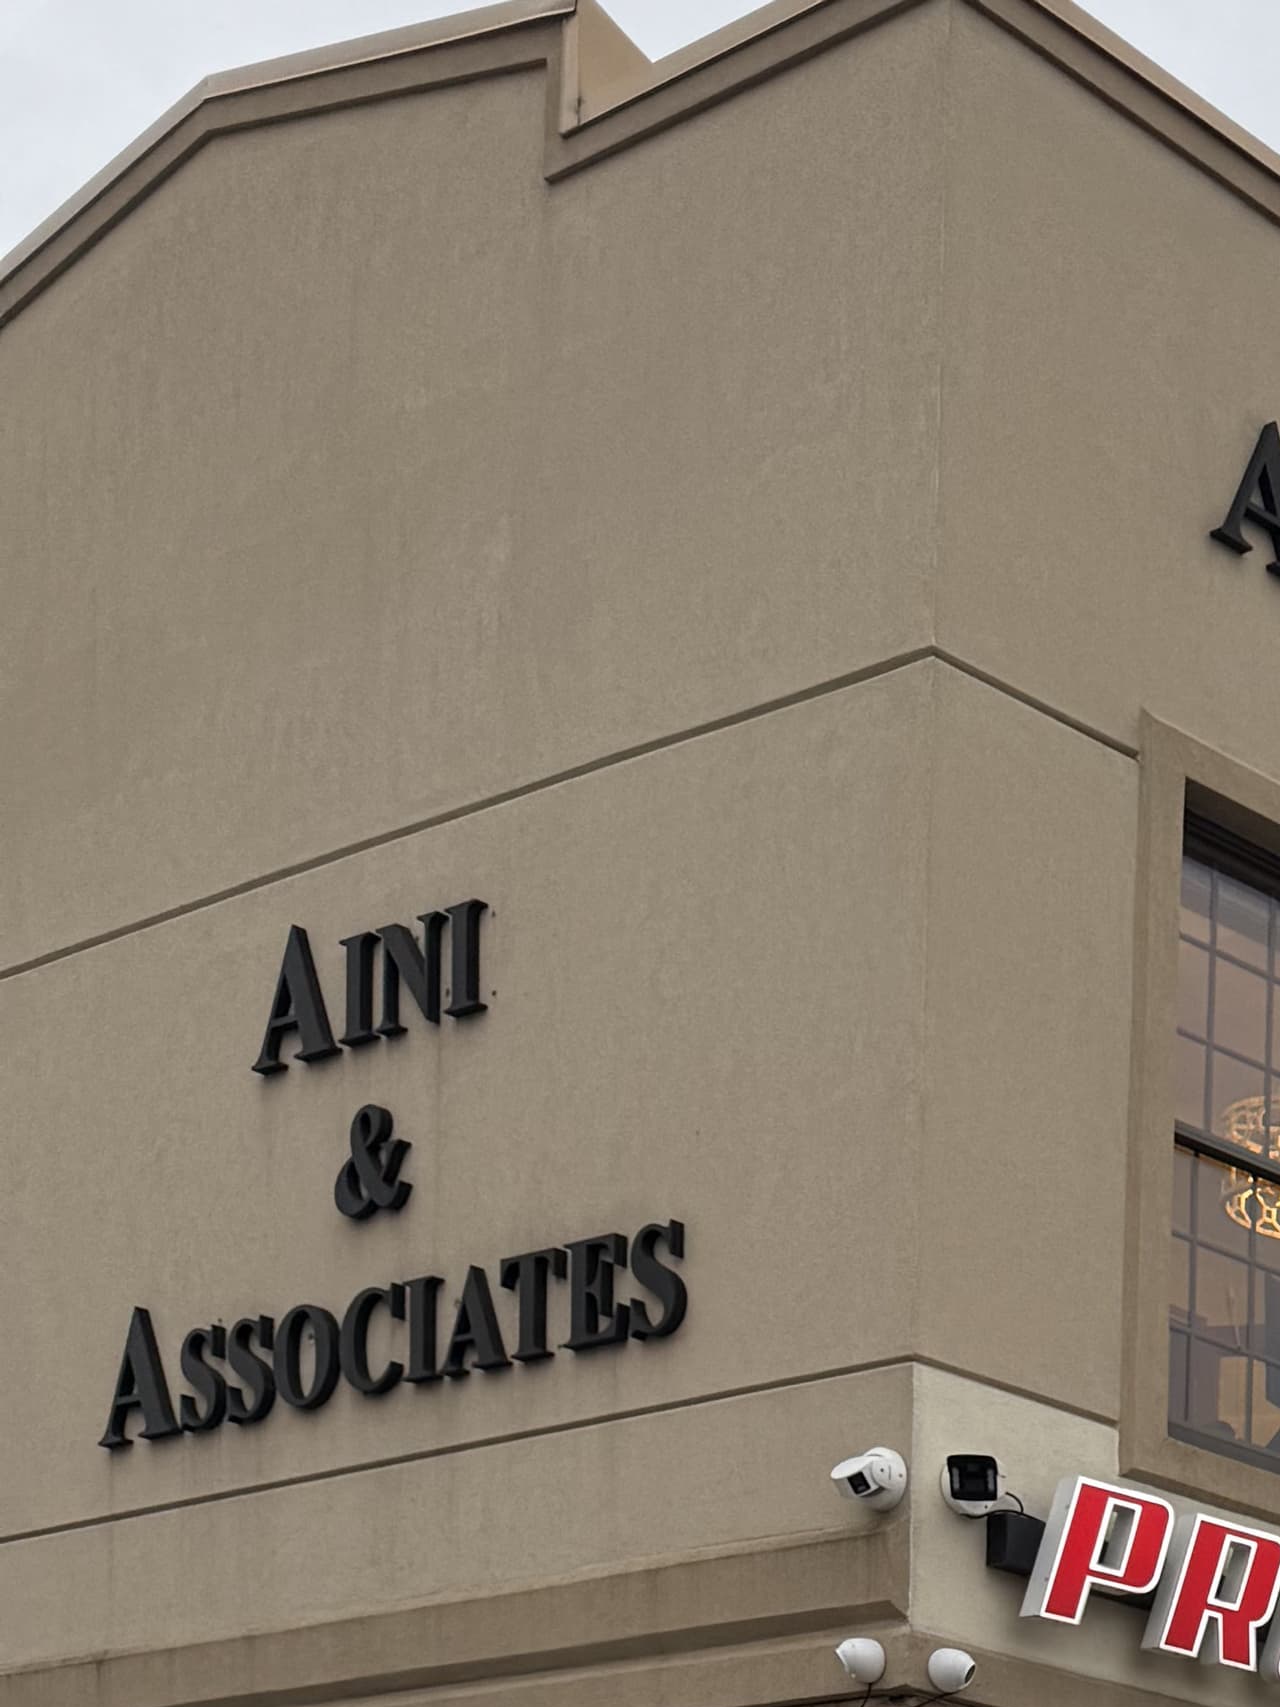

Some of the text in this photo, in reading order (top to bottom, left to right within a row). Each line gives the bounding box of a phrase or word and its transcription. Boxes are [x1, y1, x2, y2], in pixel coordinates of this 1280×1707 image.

[251, 899, 488, 1075] AINI
[334, 1104, 412, 1219] &
[98, 1219, 688, 1448] ASSOCIATES
